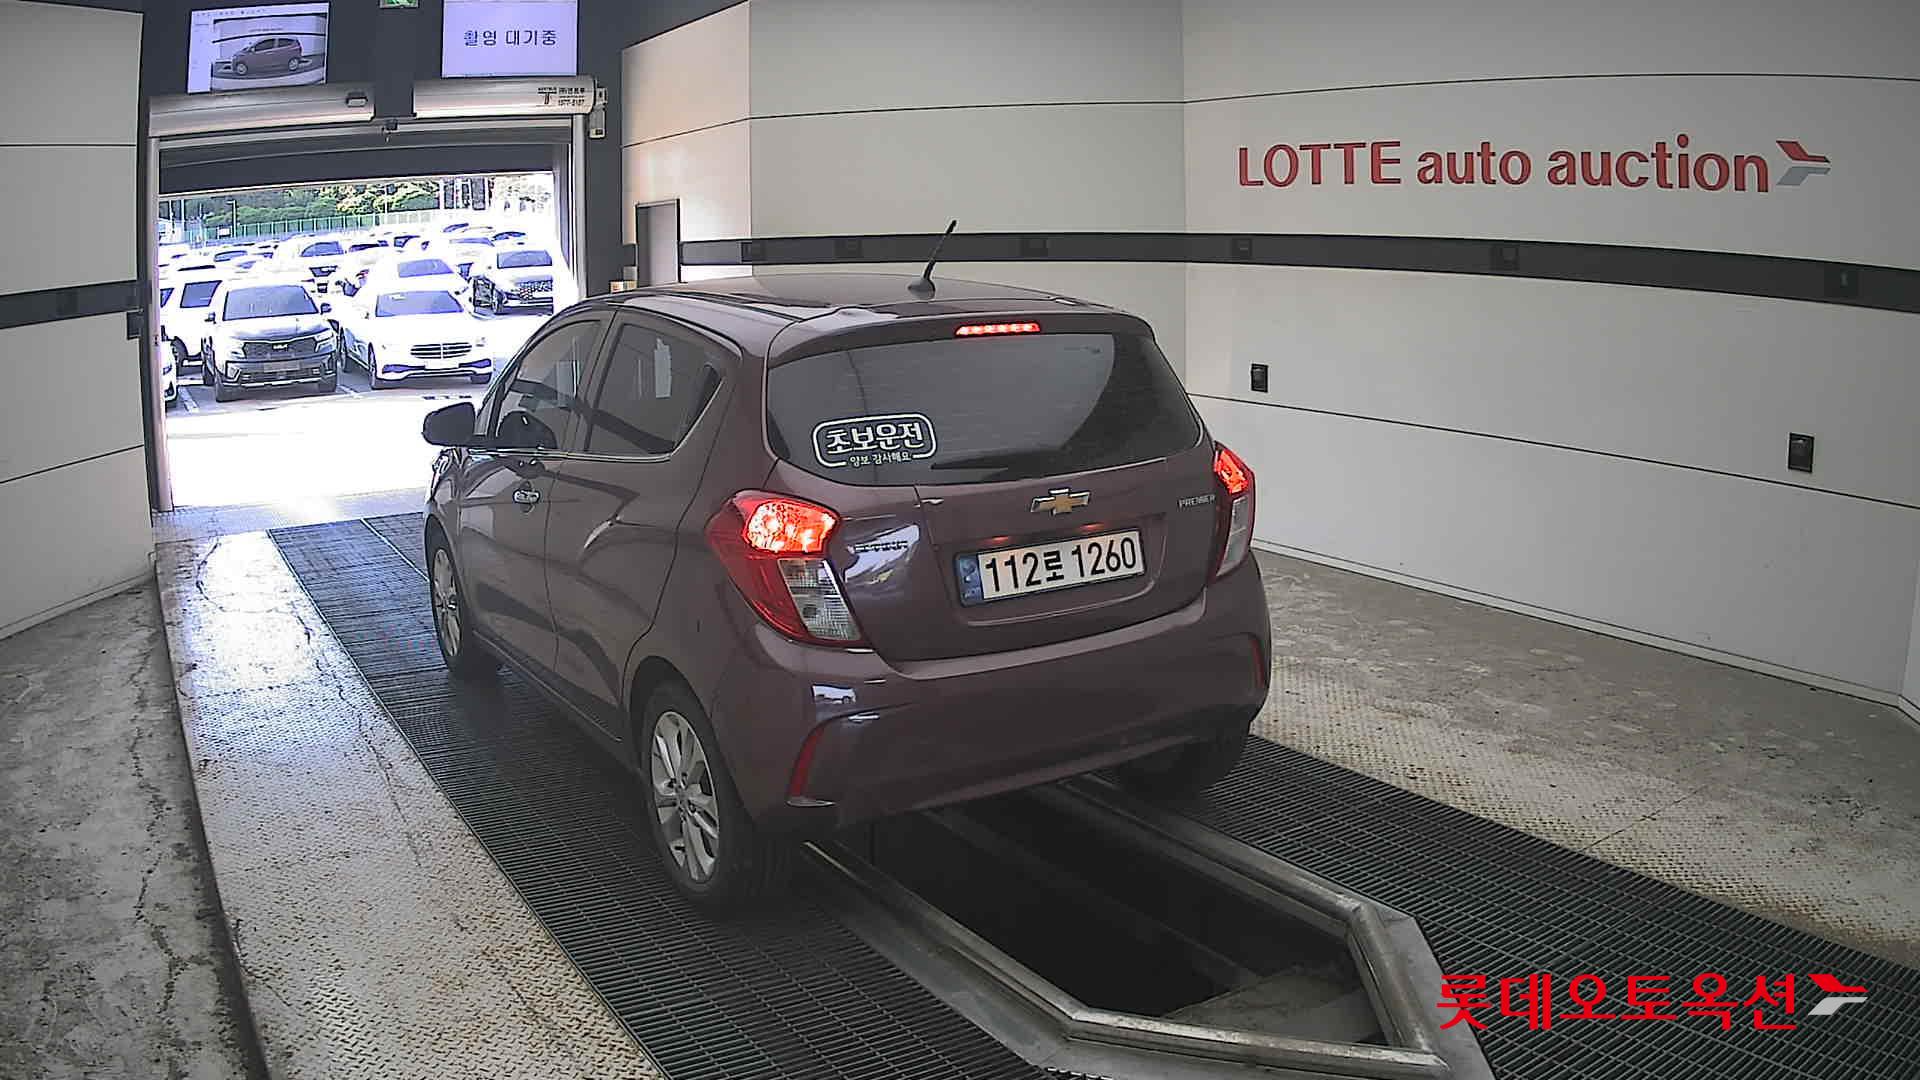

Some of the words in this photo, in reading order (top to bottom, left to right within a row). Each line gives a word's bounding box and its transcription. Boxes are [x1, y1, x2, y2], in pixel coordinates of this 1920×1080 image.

[505, 30, 556, 46] 대기중
[1239, 141, 1401, 188] LOTTE
[1417, 141, 1532, 185] auto
[1547, 134, 1769, 193] auction
[826, 422, 925, 454] 초보운전
[985, 550, 1065, 592] 112로
[1072, 537, 1137, 578] 1260
